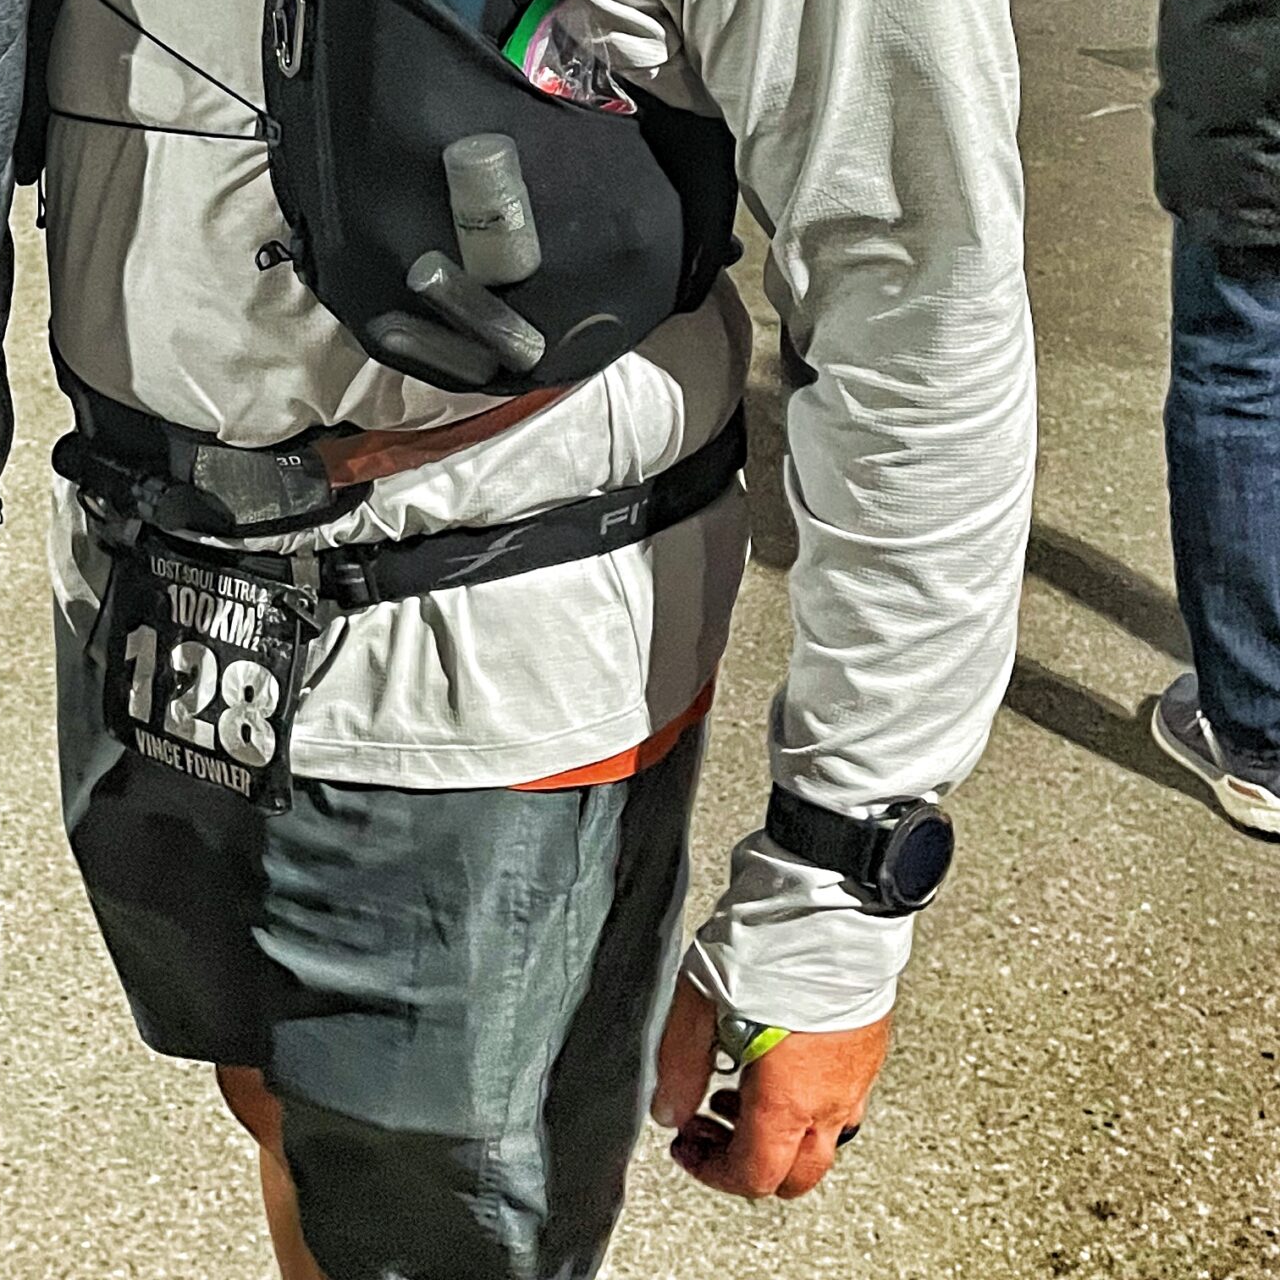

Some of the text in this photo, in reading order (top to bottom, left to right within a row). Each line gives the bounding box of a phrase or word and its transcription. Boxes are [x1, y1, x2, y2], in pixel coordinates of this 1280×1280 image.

[276, 455, 301, 466] 3D
[601, 497, 649, 535] FI
[151, 556, 257, 603] LOST SOUL ULTRA
[167, 584, 256, 649] 100KM
[124, 624, 280, 768] 128
[135, 727, 252, 798] VINCE FOWLER
